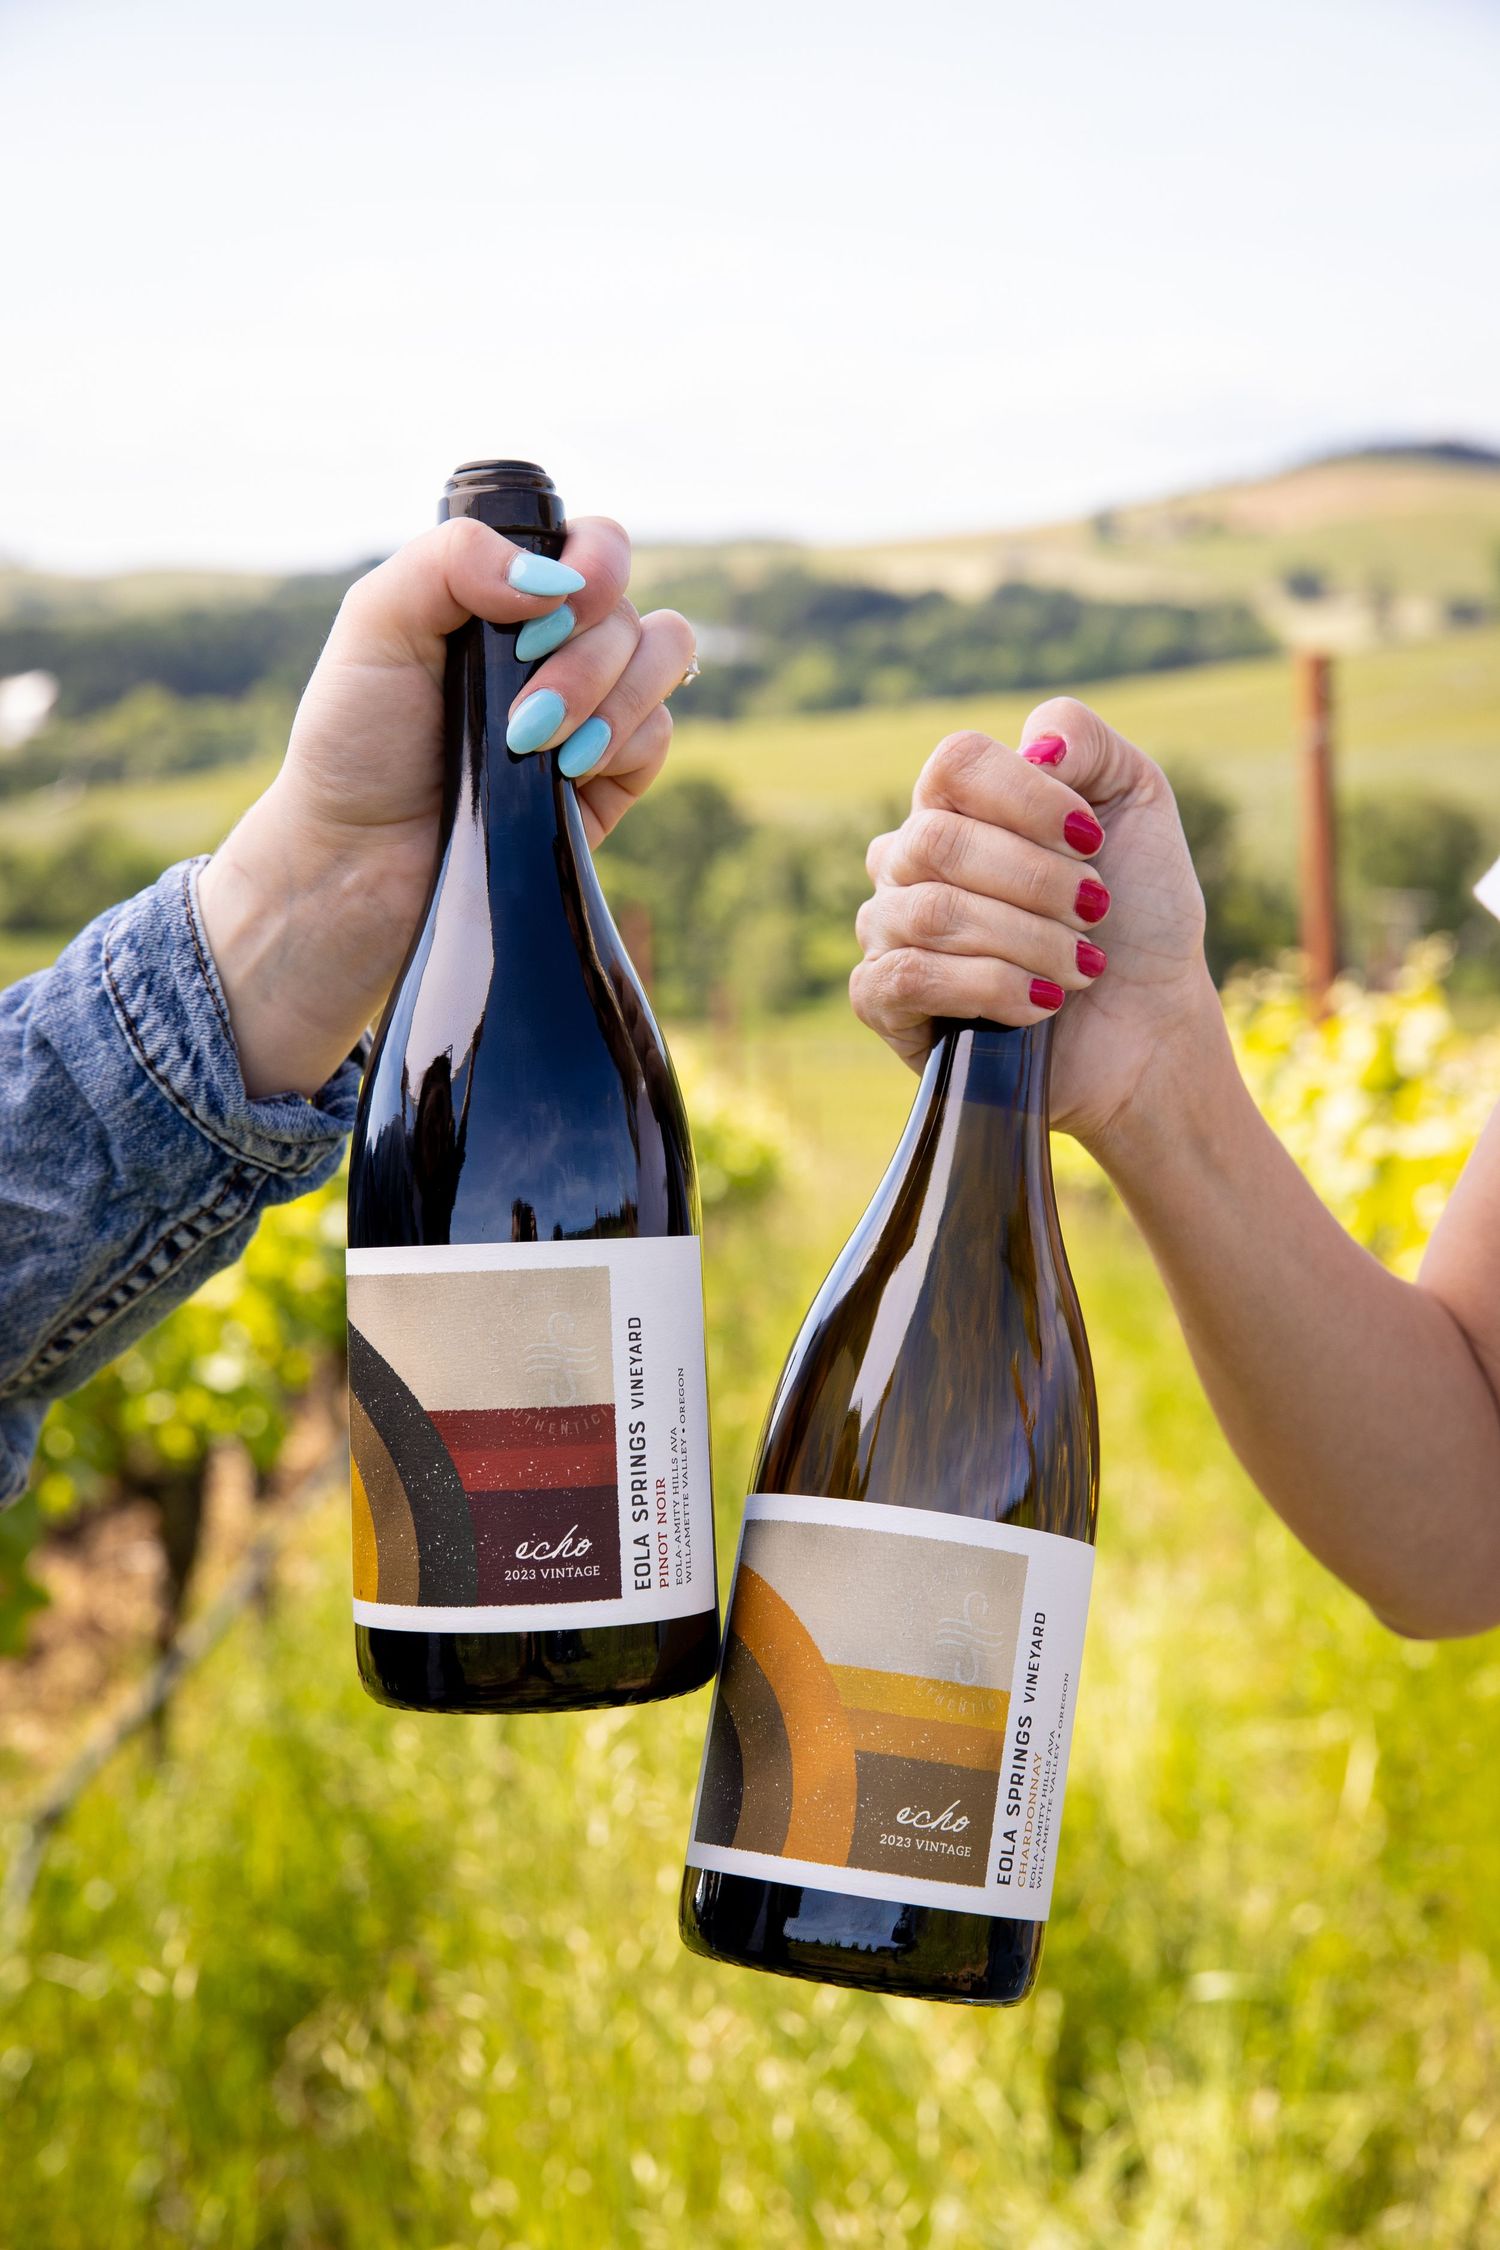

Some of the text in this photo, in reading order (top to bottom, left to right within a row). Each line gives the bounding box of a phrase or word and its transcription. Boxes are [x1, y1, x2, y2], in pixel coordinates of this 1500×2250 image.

[628, 1317, 651, 1590] EOLA SPRINGS VINEYARD
[670, 1427, 683, 1585] EOLA-AMITY HILLS AVA
[678, 1367, 692, 1583] WILLAMETTE VALLEY OREGON
[504, 1565, 600, 1581] 2023 VINTAGE
[515, 1524, 593, 1560] echo
[656, 1477, 669, 1589] PINOT NOIR
[896, 1799, 970, 1832] echo
[996, 1612, 1046, 1886] EOLA SPRINGS VINEYARD
[1017, 1752, 1042, 1887] CHARDONNAY
[1029, 1730, 1056, 1889] EOLA-AMITY HILLS AVA
[1036, 1673, 1069, 1889] WILLAMETTE VALLEY OREGON
[880, 1834, 972, 1857] 2023 VINTAGE
